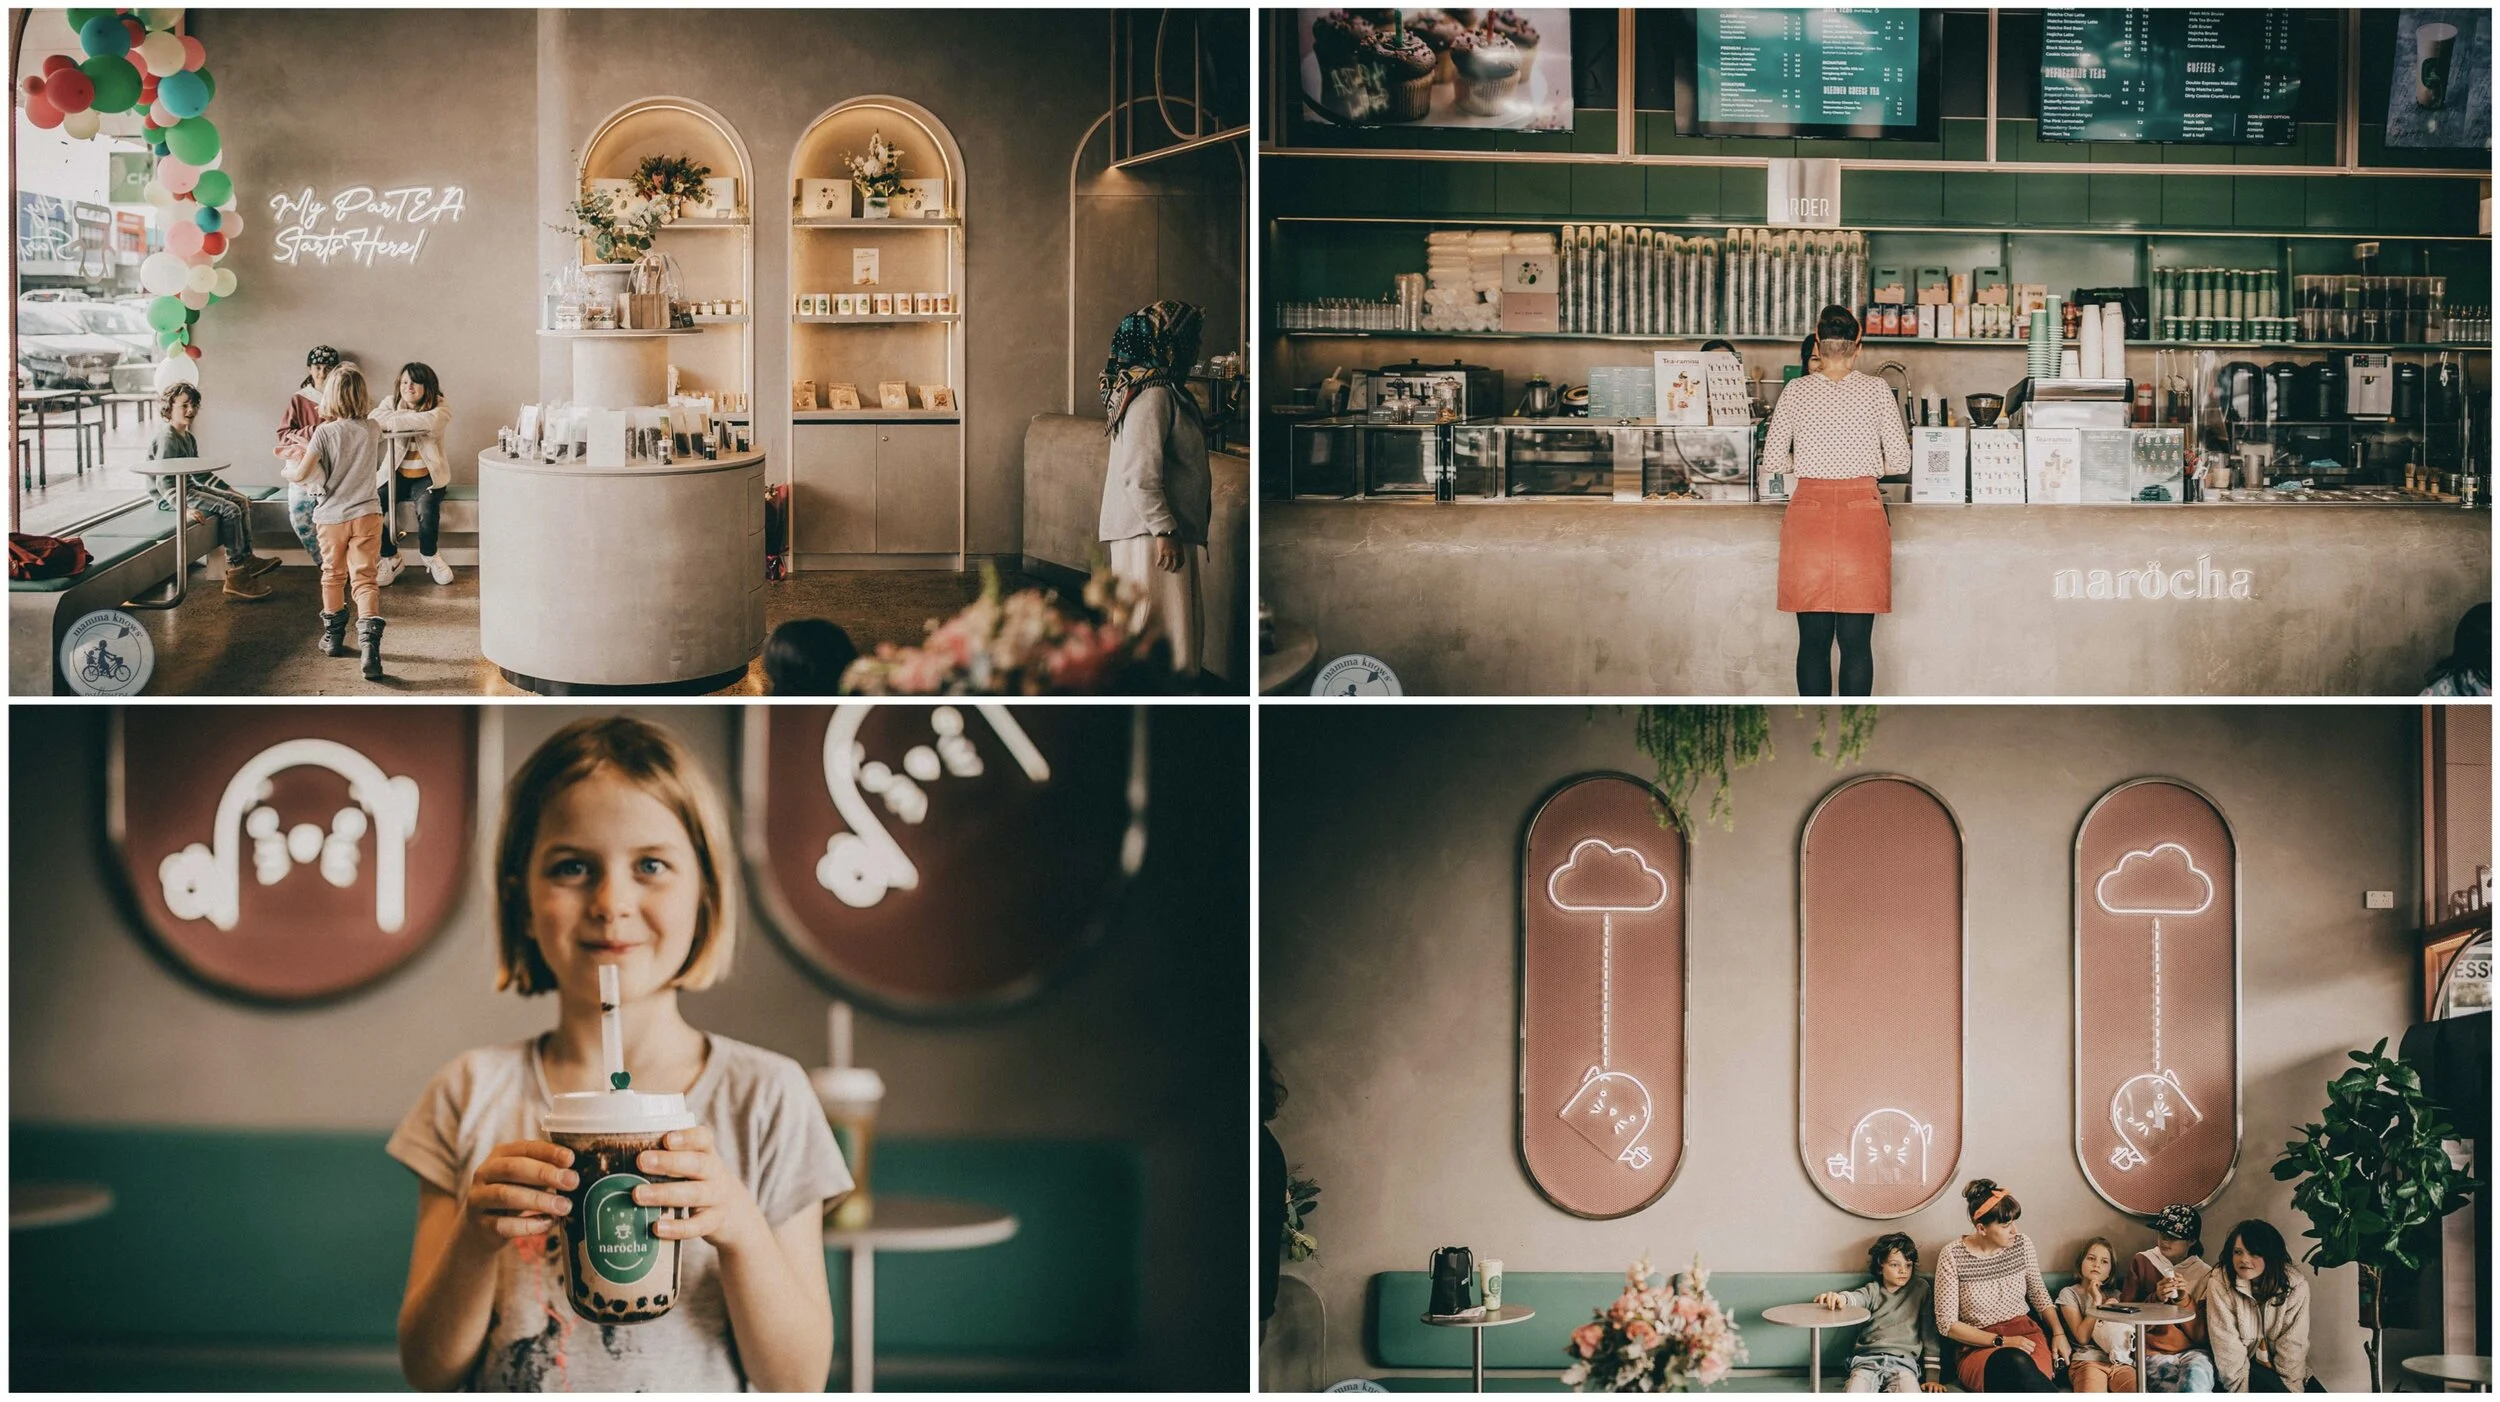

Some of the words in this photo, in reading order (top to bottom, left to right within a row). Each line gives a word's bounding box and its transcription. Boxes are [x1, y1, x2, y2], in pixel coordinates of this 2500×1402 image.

[270, 187, 326, 230] My
[333, 186, 464, 223] ParTEA
[1787, 198, 1830, 217] RDER
[274, 226, 350, 265] Starts
[2454, 961, 2492, 979] ESS
